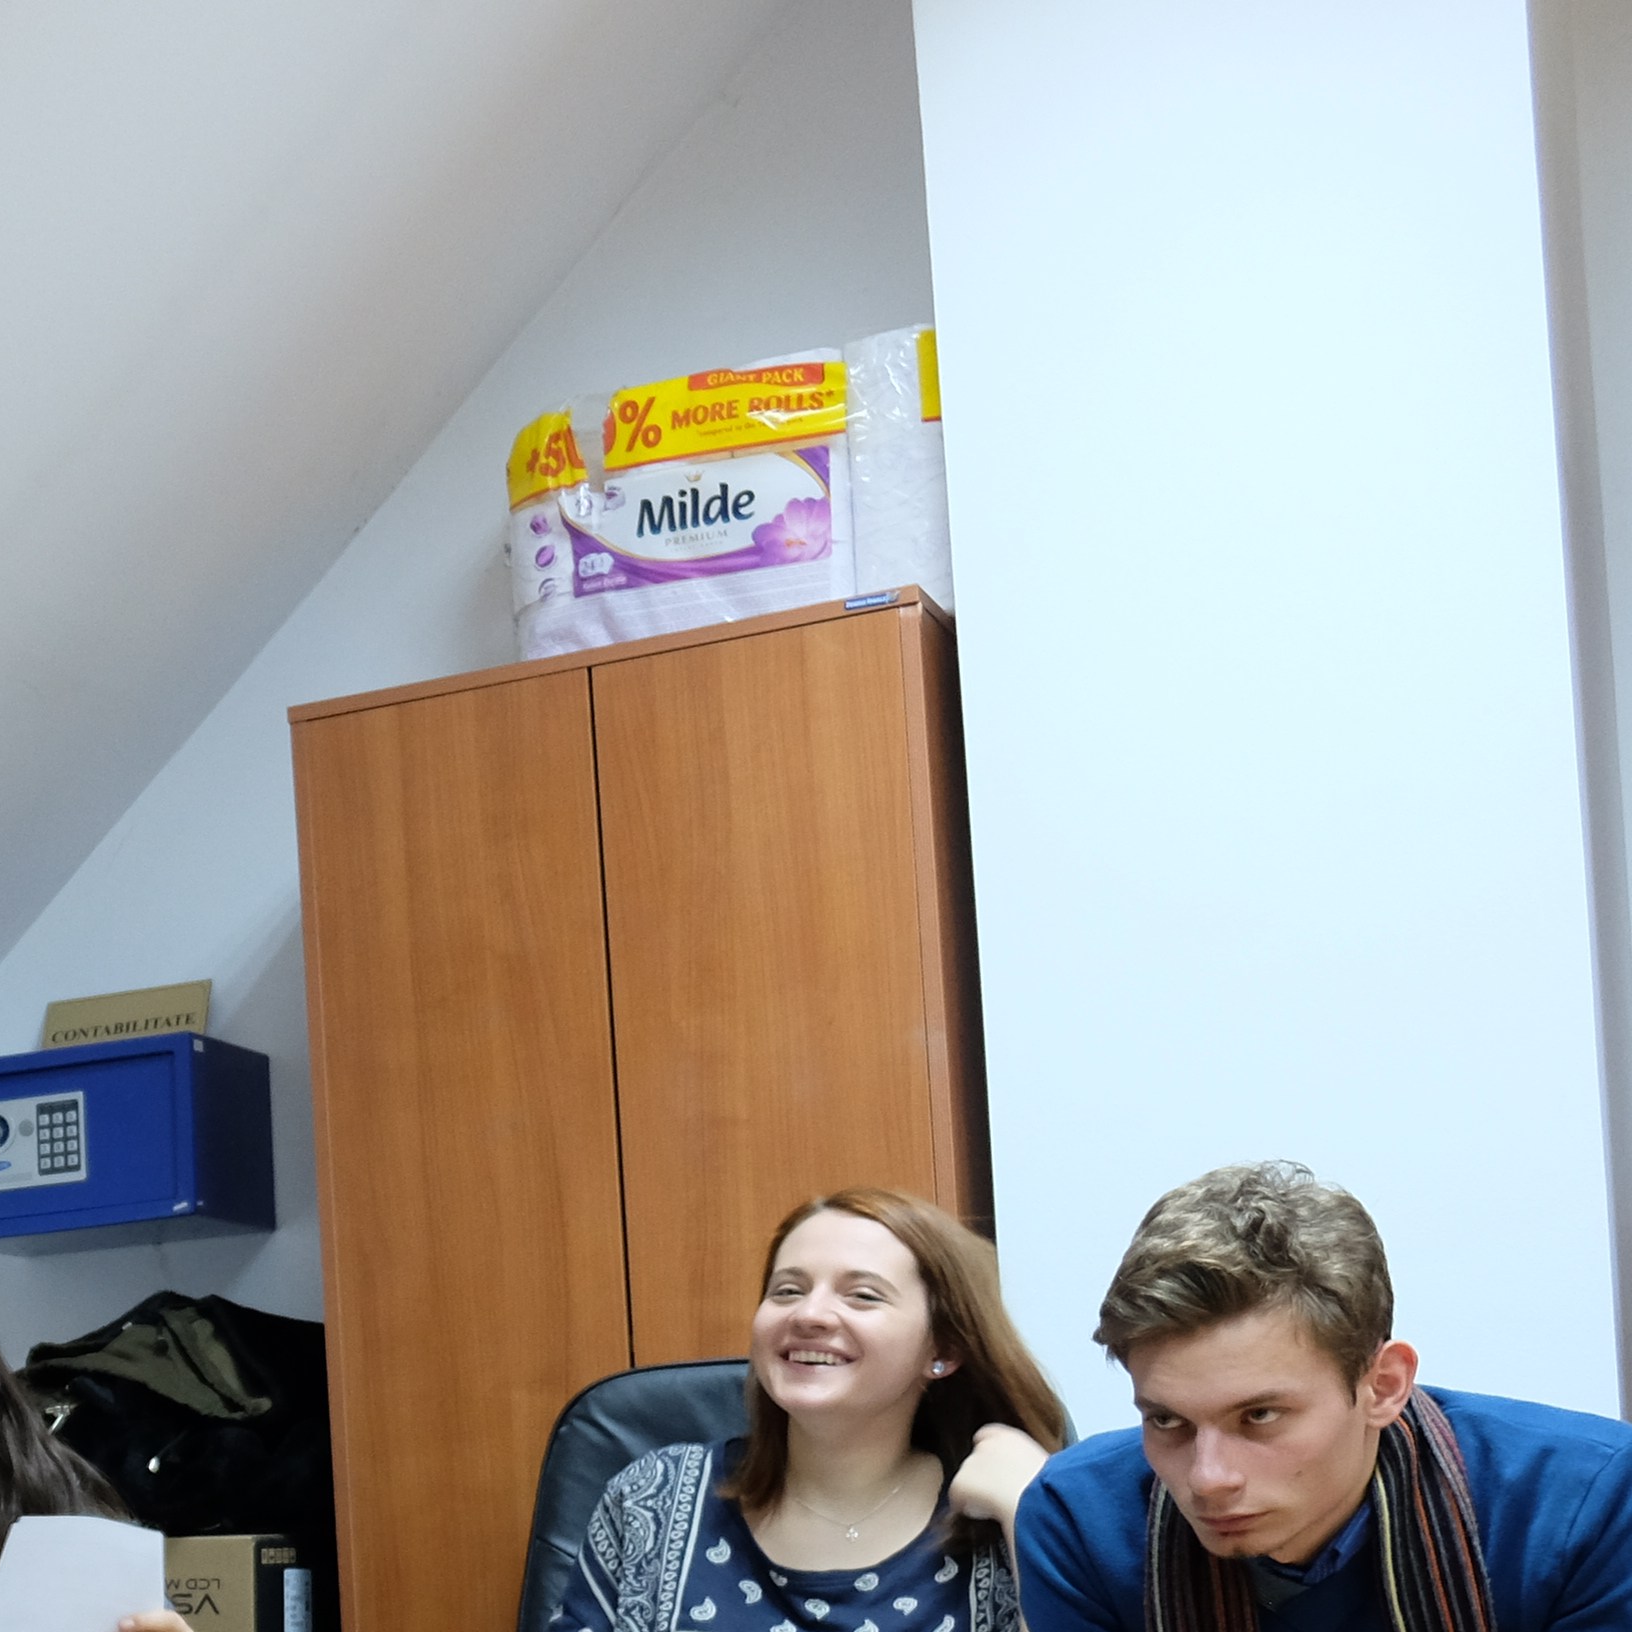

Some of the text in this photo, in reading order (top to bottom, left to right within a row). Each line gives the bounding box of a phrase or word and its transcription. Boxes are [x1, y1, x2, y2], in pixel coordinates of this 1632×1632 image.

[707, 367, 805, 386] GIANT PACK
[670, 399, 739, 430] MORE
[636, 482, 756, 538] Milde
[664, 529, 729, 546] PREMIUM
[51, 1011, 197, 1044] CONTABILITATE
[185, 1578, 221, 1591] LCD
